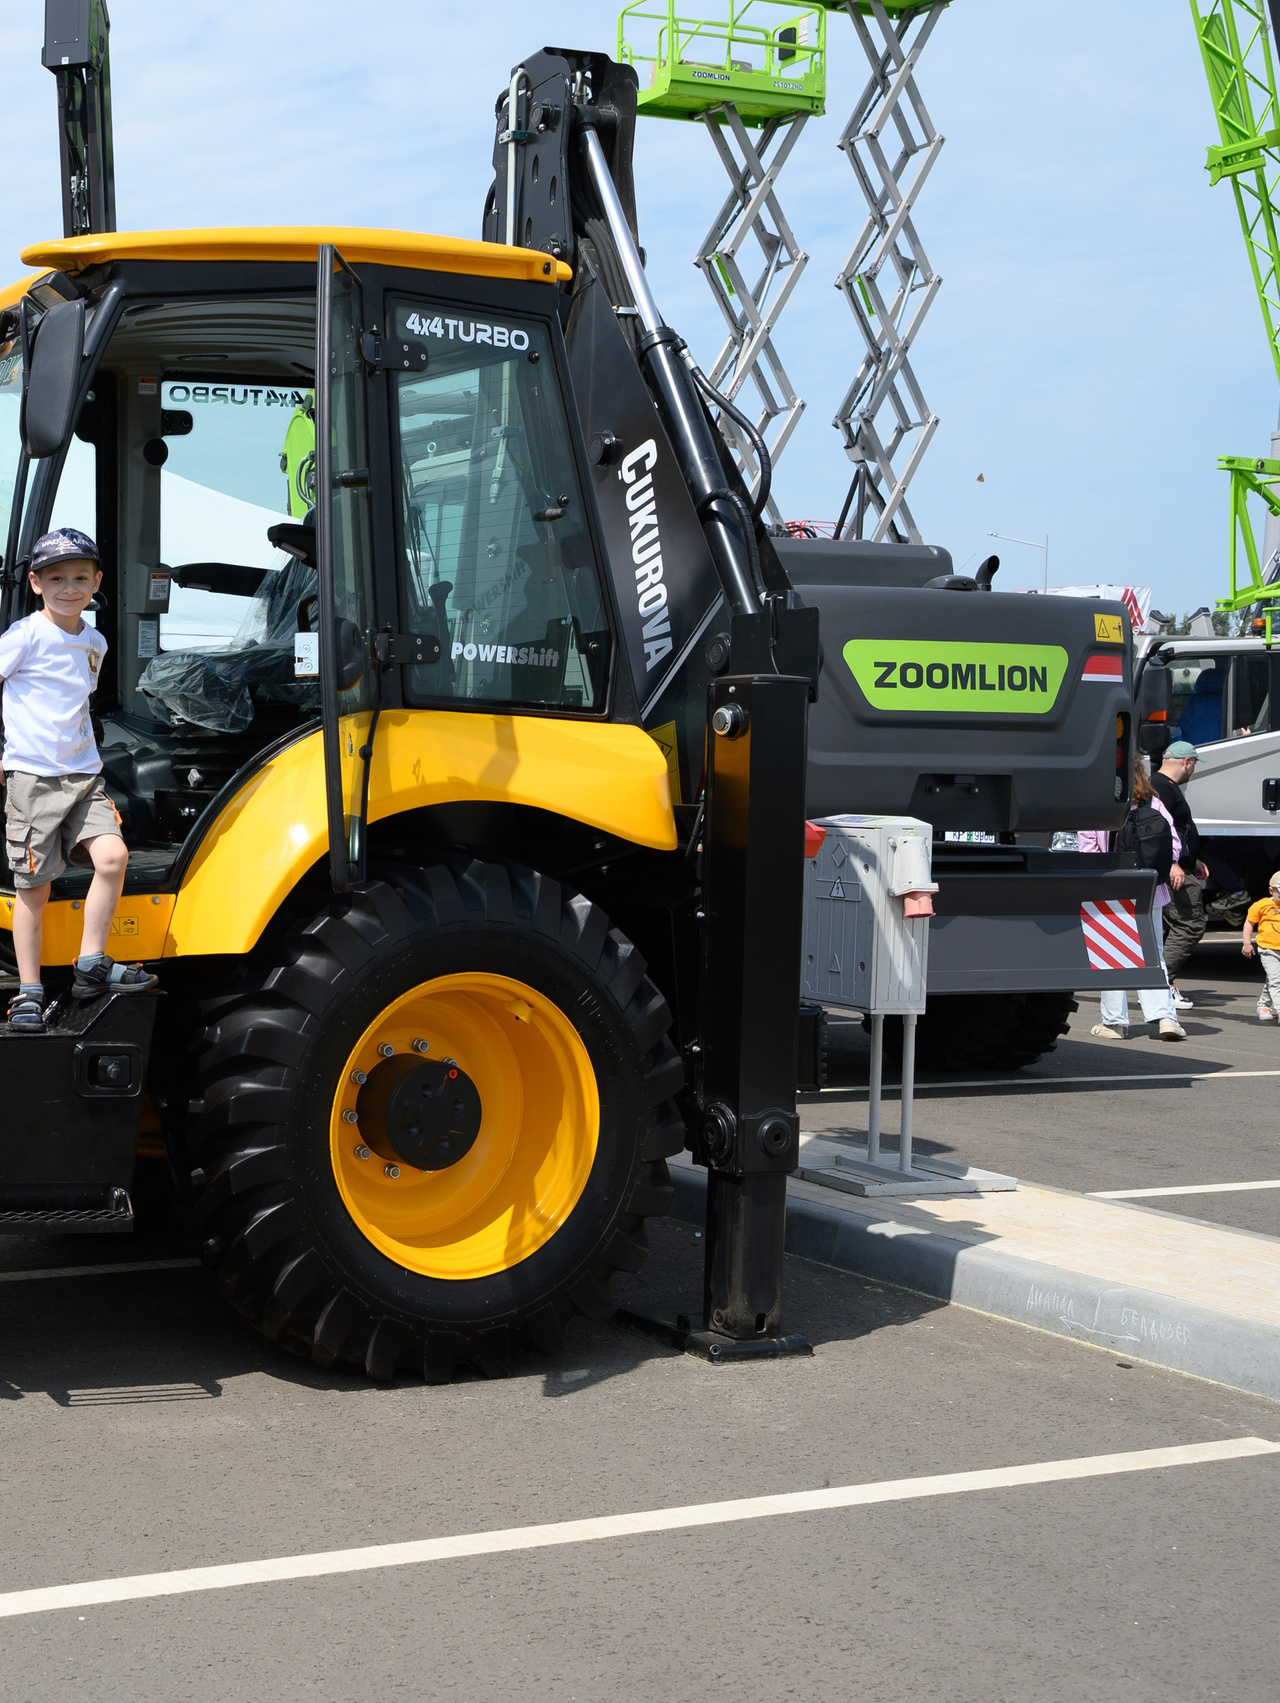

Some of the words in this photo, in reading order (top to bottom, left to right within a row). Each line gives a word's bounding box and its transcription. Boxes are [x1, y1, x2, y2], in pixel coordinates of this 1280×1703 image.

[692, 71, 731, 81] ZOOMLION
[618, 438, 673, 673] ÇUKUROVA
[451, 642, 560, 667] POWERShift
[873, 661, 1048, 692] ZOOMLION
